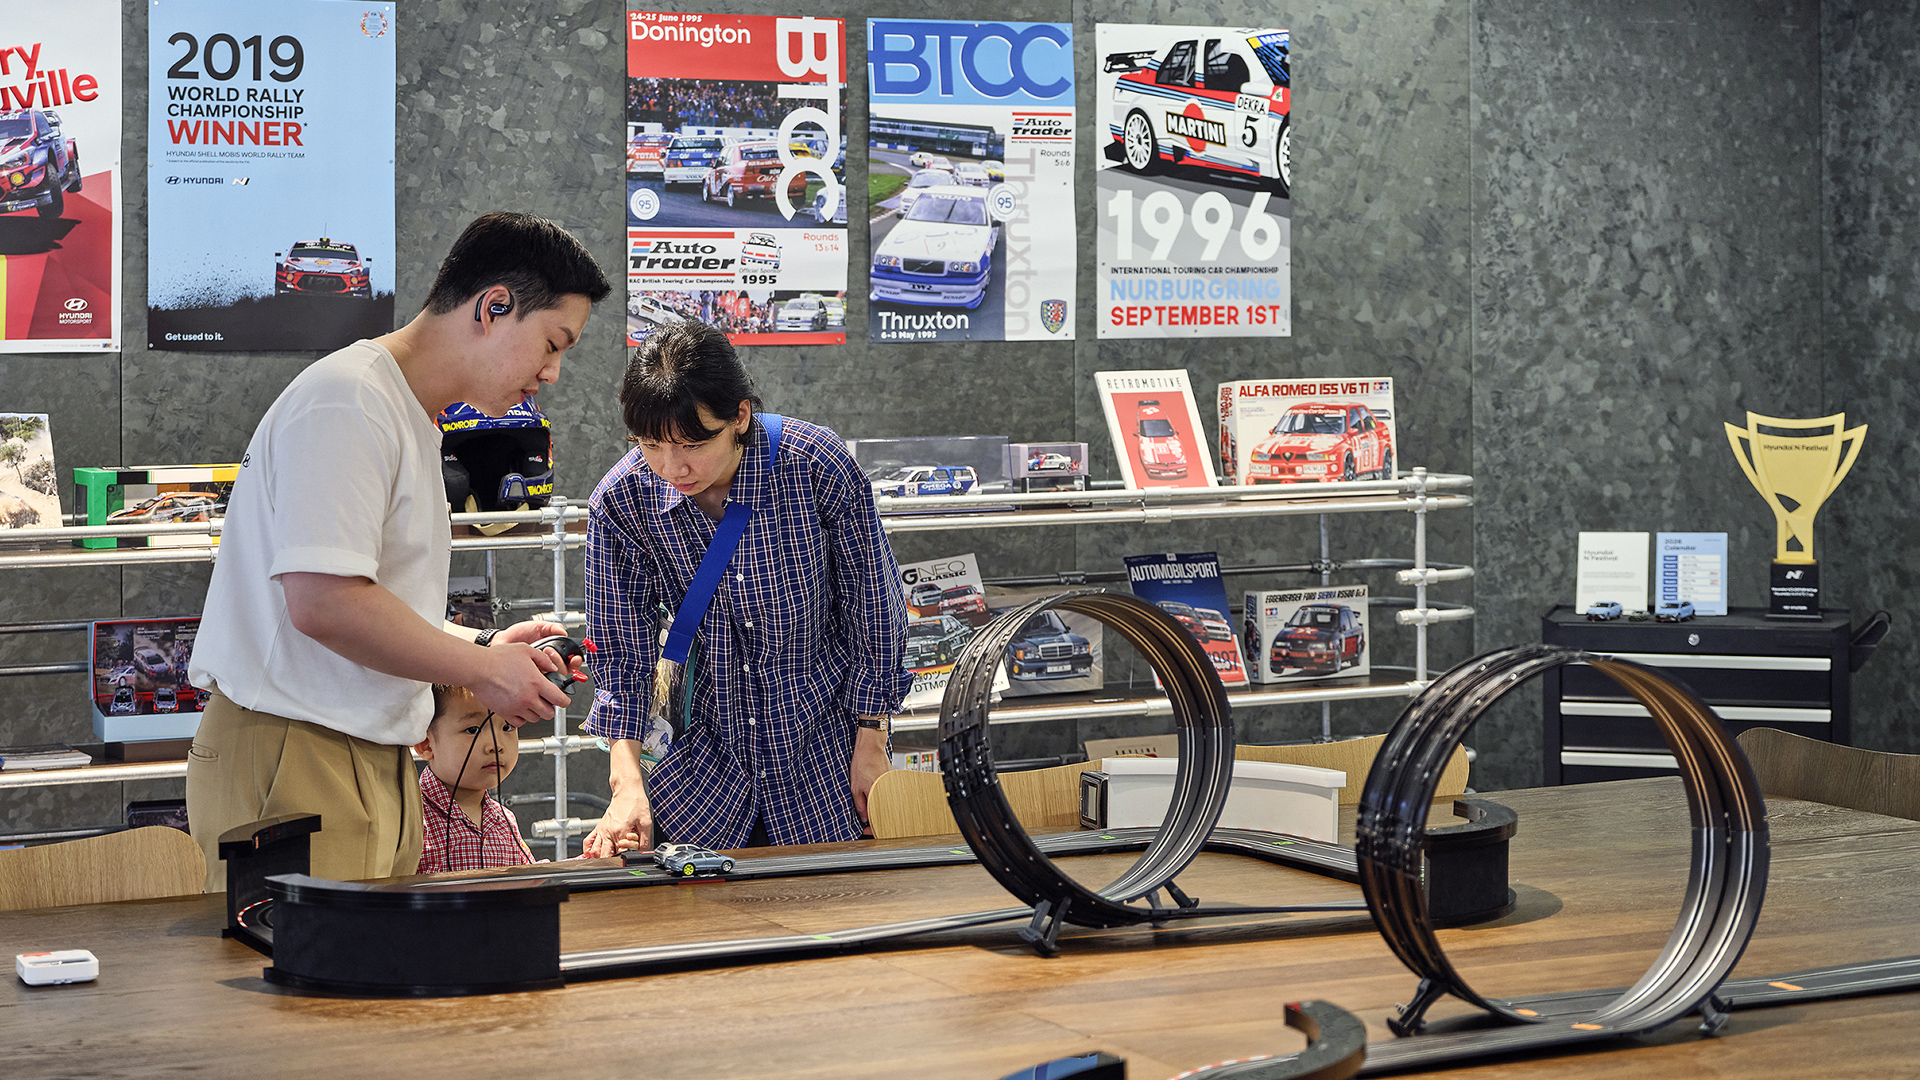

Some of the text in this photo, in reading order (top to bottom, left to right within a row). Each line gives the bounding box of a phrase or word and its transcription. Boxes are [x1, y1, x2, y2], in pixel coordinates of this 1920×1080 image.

[631, 13, 703, 23] 24-25 June 1995
[631, 21, 751, 48] Donington
[167, 32, 305, 82] 2019
[867, 22, 1073, 100] BTCC
[168, 86, 305, 104] WORLD RALLY
[1237, 95, 1266, 114] DEKRA
[167, 104, 304, 119] CHAMPIONSHIP
[1024, 118, 1062, 126] Auto
[1012, 127, 1072, 136] Trader
[1167, 113, 1226, 145] MARTINI
[1241, 115, 1260, 148] 5
[635, 152, 660, 160] TOTAL
[1040, 149, 1071, 157] Rounds
[183, 177, 224, 185] HYUNDAI
[931, 193, 972, 202] VOLVO
[997, 197, 1013, 210] 95
[638, 200, 652, 210] 95
[1108, 189, 1282, 262] 1996
[803, 233, 840, 242] Rounds
[1004, 147, 1038, 337] Thruxton
[650, 241, 717, 254] Auto
[629, 256, 736, 270] Trader
[1111, 267, 1172, 275] INTERNATIONAL
[741, 275, 778, 285] 1995
[1110, 278, 1281, 301] NURBURGRING
[878, 311, 969, 330] Thruxton
[1111, 306, 1240, 326] SEPTEMBER
[1246, 305, 1281, 325] 1ST
[165, 332, 224, 343] Get used to it.
[880, 330, 937, 341] 6-8 May 1995
[1106, 377, 1183, 389] RETROMOTIVE
[1239, 382, 1370, 397] ALFA ROMEO 155 V6 TI
[1763, 444, 1793, 452] Hyundai
[920, 570, 967, 583] CLASSIC
[1130, 561, 1219, 582] AUTOMOBILSPORT
[1317, 590, 1337, 600] SIERRA
